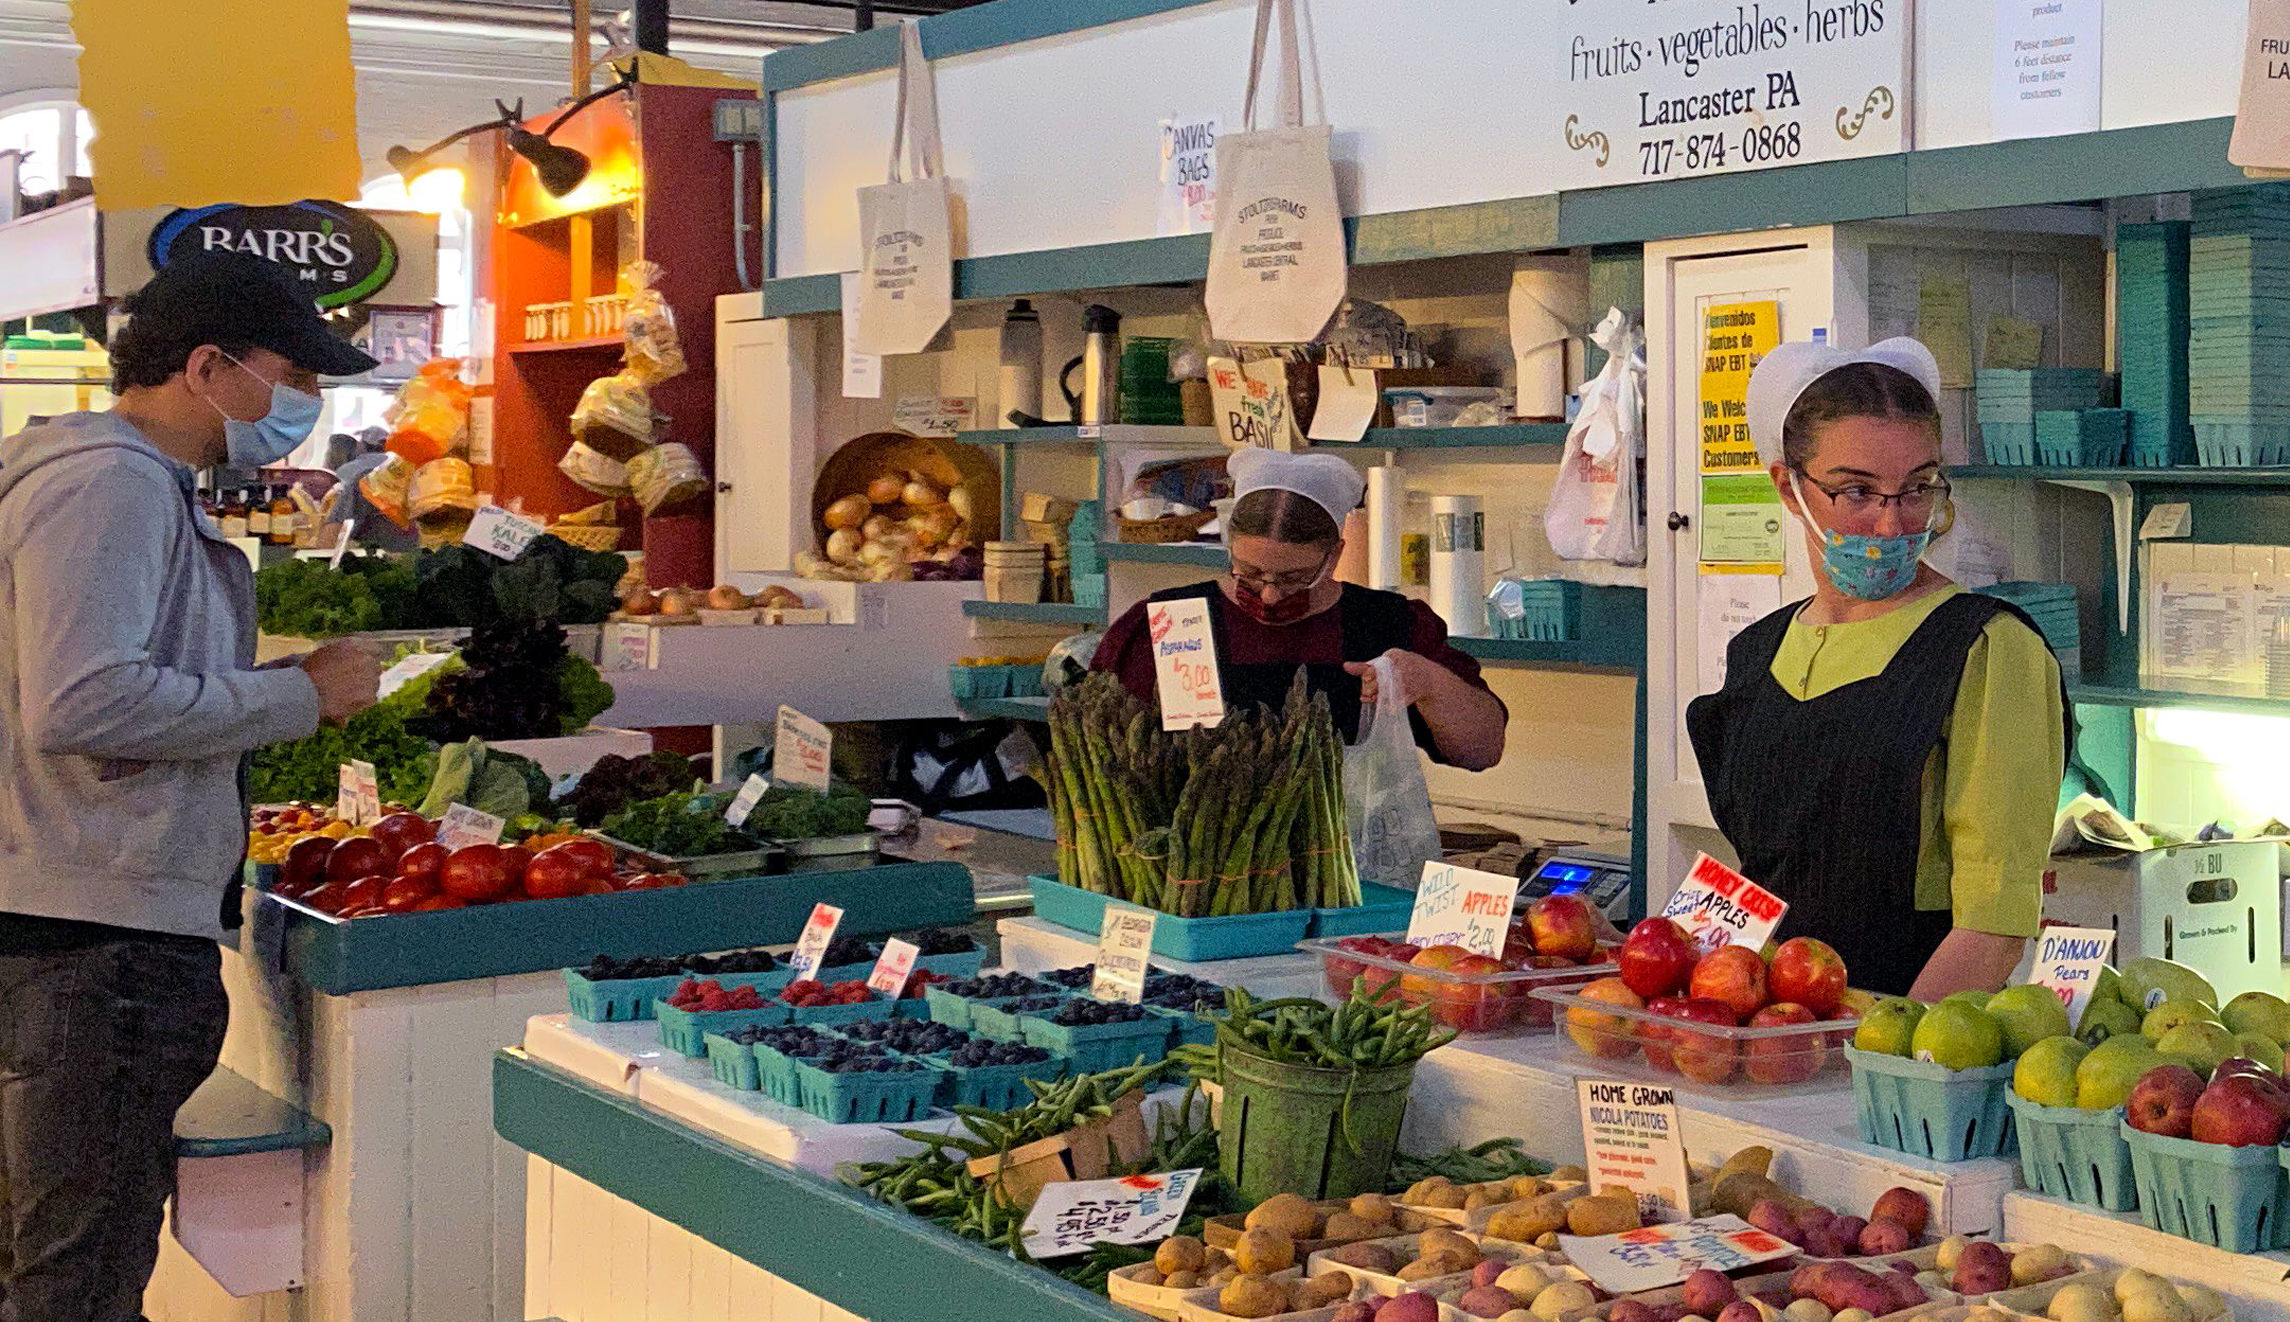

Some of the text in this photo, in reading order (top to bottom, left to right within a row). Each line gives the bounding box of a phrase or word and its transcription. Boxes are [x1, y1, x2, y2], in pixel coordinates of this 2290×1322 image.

[1571, 0, 1884, 81] fruits vegetables herbs
[2014, 39, 2040, 51] Please
[2014, 53, 2072, 67] 6 feet distance
[2019, 72, 2039, 84] from
[1639, 70, 1800, 127] Lancaster PA
[2020, 88, 2062, 100] customers
[1639, 121, 1801, 175] 717-874-0868
[1178, 153, 1209, 186] BAGS
[1741, 332, 1753, 349] de
[1729, 354, 1746, 372] EBT
[1703, 400, 1746, 418] We Welc
[1704, 425, 1731, 443] SNAP
[1704, 449, 1760, 468] Customers
[2208, 853, 2222, 874] BU
[1461, 890, 1509, 918] APPLES
[1700, 891, 1750, 930] APPLES
[2042, 935, 2107, 964] D'ANJOU
[2053, 965, 2090, 980] Pears
[1590, 1083, 1674, 1106] HOME GROWN
[1590, 1106, 1668, 1131] NICOLA POTATOES
